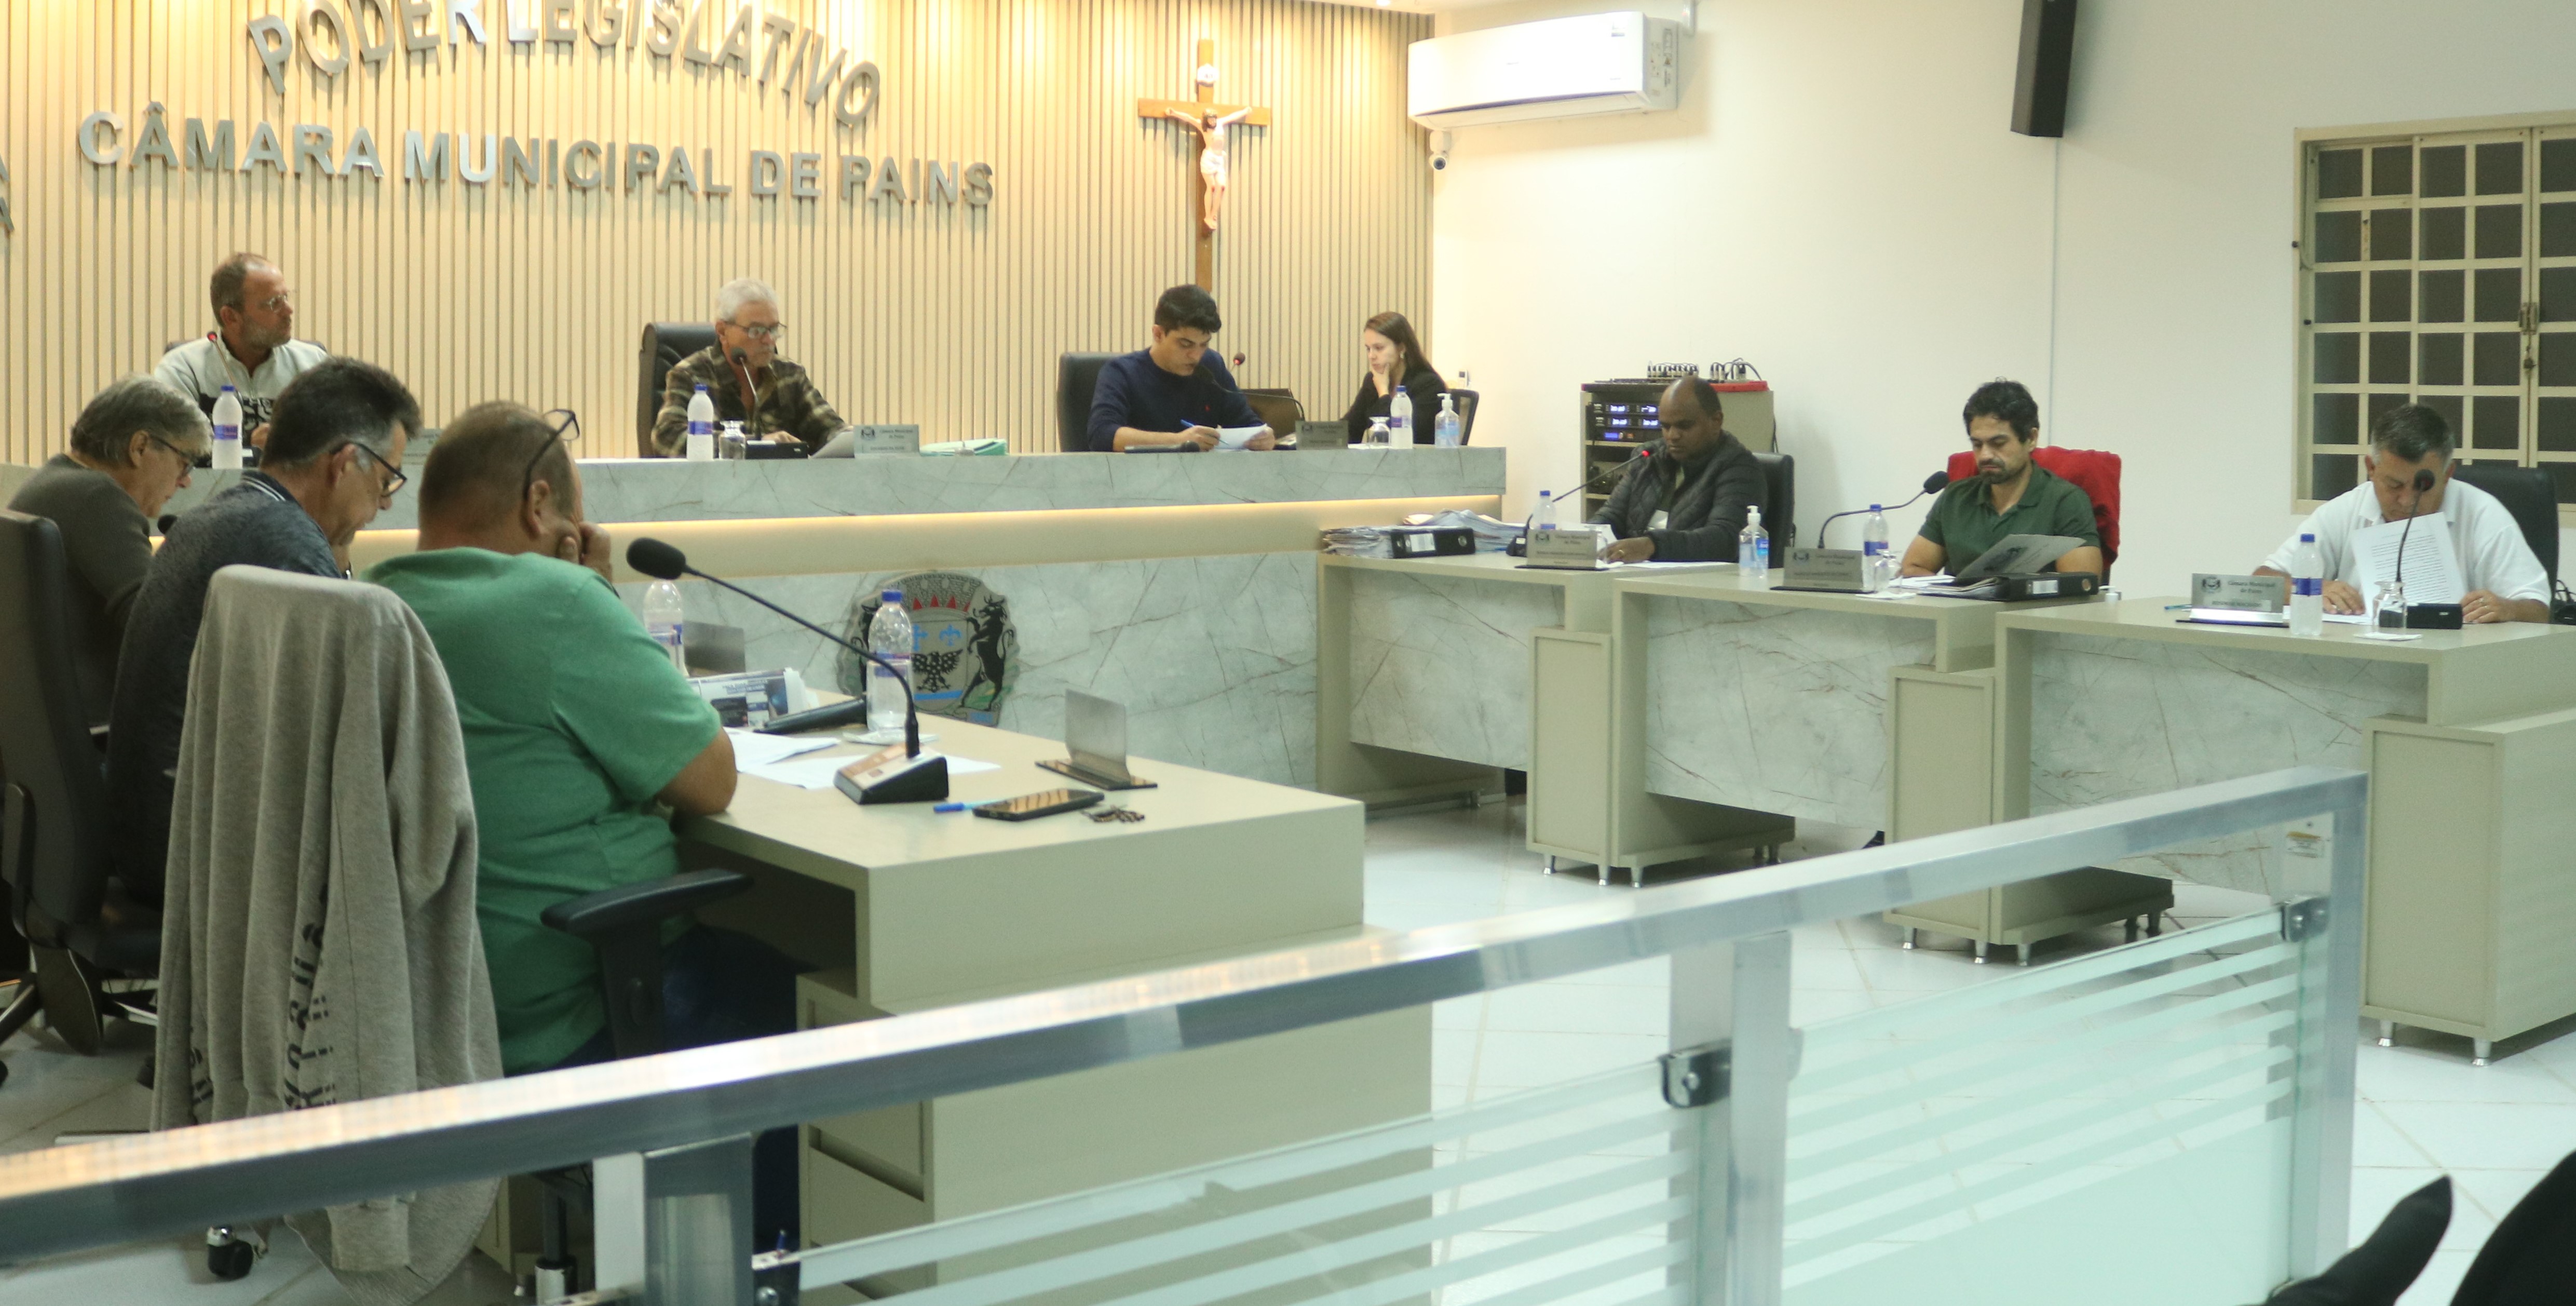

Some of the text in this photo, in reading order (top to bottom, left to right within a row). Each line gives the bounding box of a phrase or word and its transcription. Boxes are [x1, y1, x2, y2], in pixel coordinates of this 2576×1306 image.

[248, 0, 880, 126] PODER LEGISLATIVO
[78, 101, 384, 178] CÂMARA
[404, 130, 732, 194] MUNICIPAL
[750, 150, 822, 197] DE
[840, 155, 993, 206] PAINS
